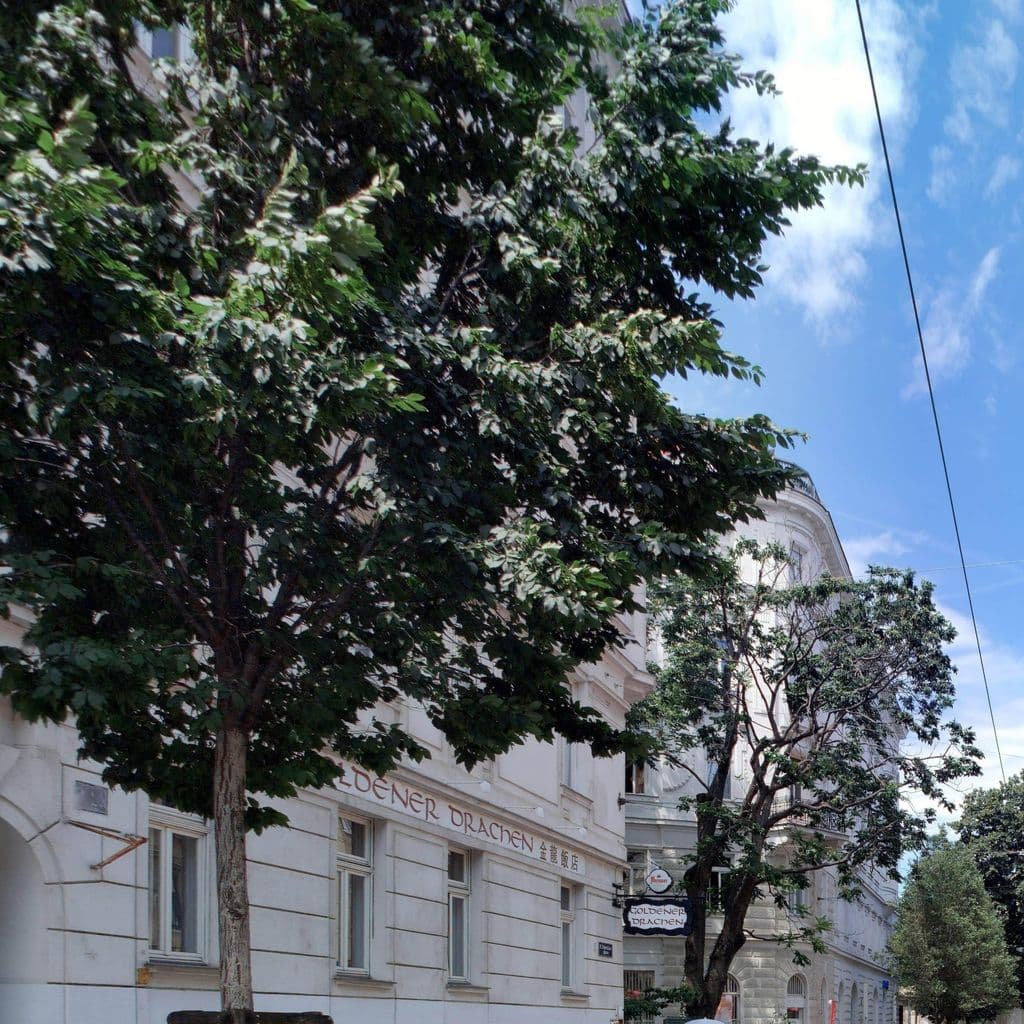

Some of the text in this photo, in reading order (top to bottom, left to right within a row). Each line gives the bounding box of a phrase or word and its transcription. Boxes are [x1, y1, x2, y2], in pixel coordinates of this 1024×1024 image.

[336, 761, 440, 821] LDENER
[630, 907, 686, 916] GOLDENER
[632, 917, 684, 926] DRACHEN
